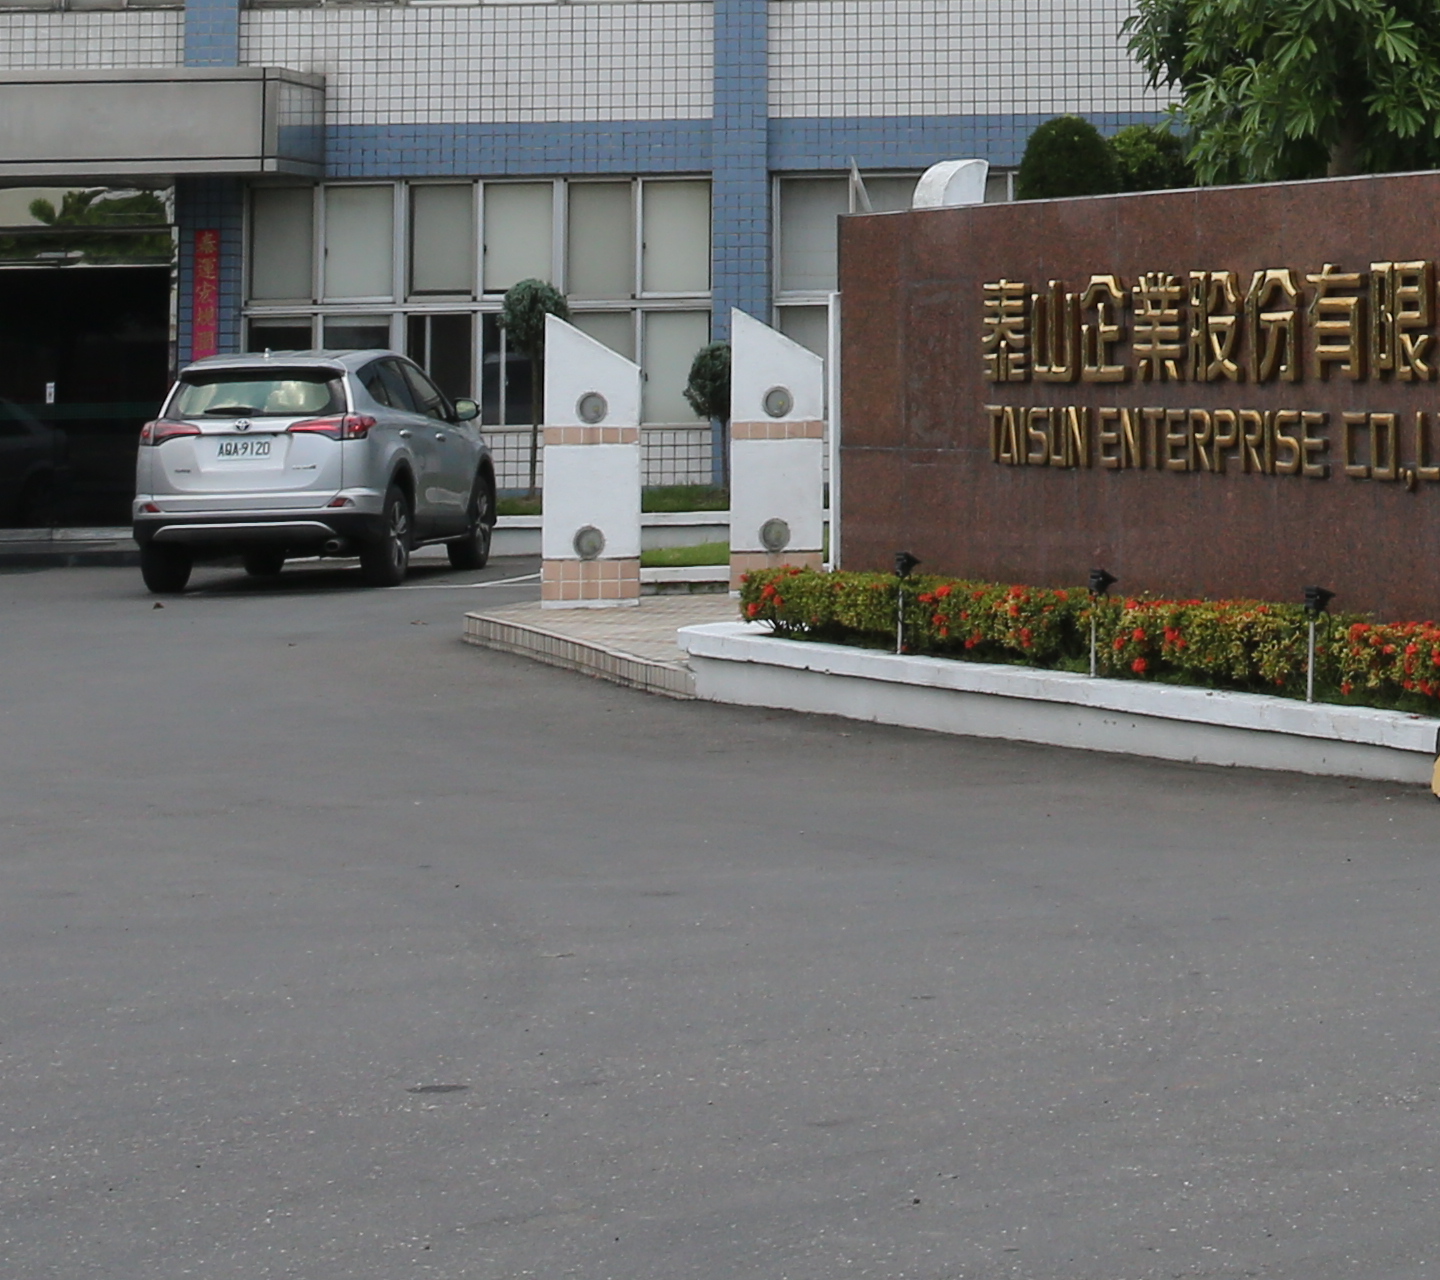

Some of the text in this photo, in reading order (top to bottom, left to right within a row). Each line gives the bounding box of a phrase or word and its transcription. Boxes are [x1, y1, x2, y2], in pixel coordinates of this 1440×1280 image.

[217, 441, 271, 458] AQA-9120
[983, 404, 1092, 469] TAISUN
[1097, 406, 1331, 479] ENTERPRISE
